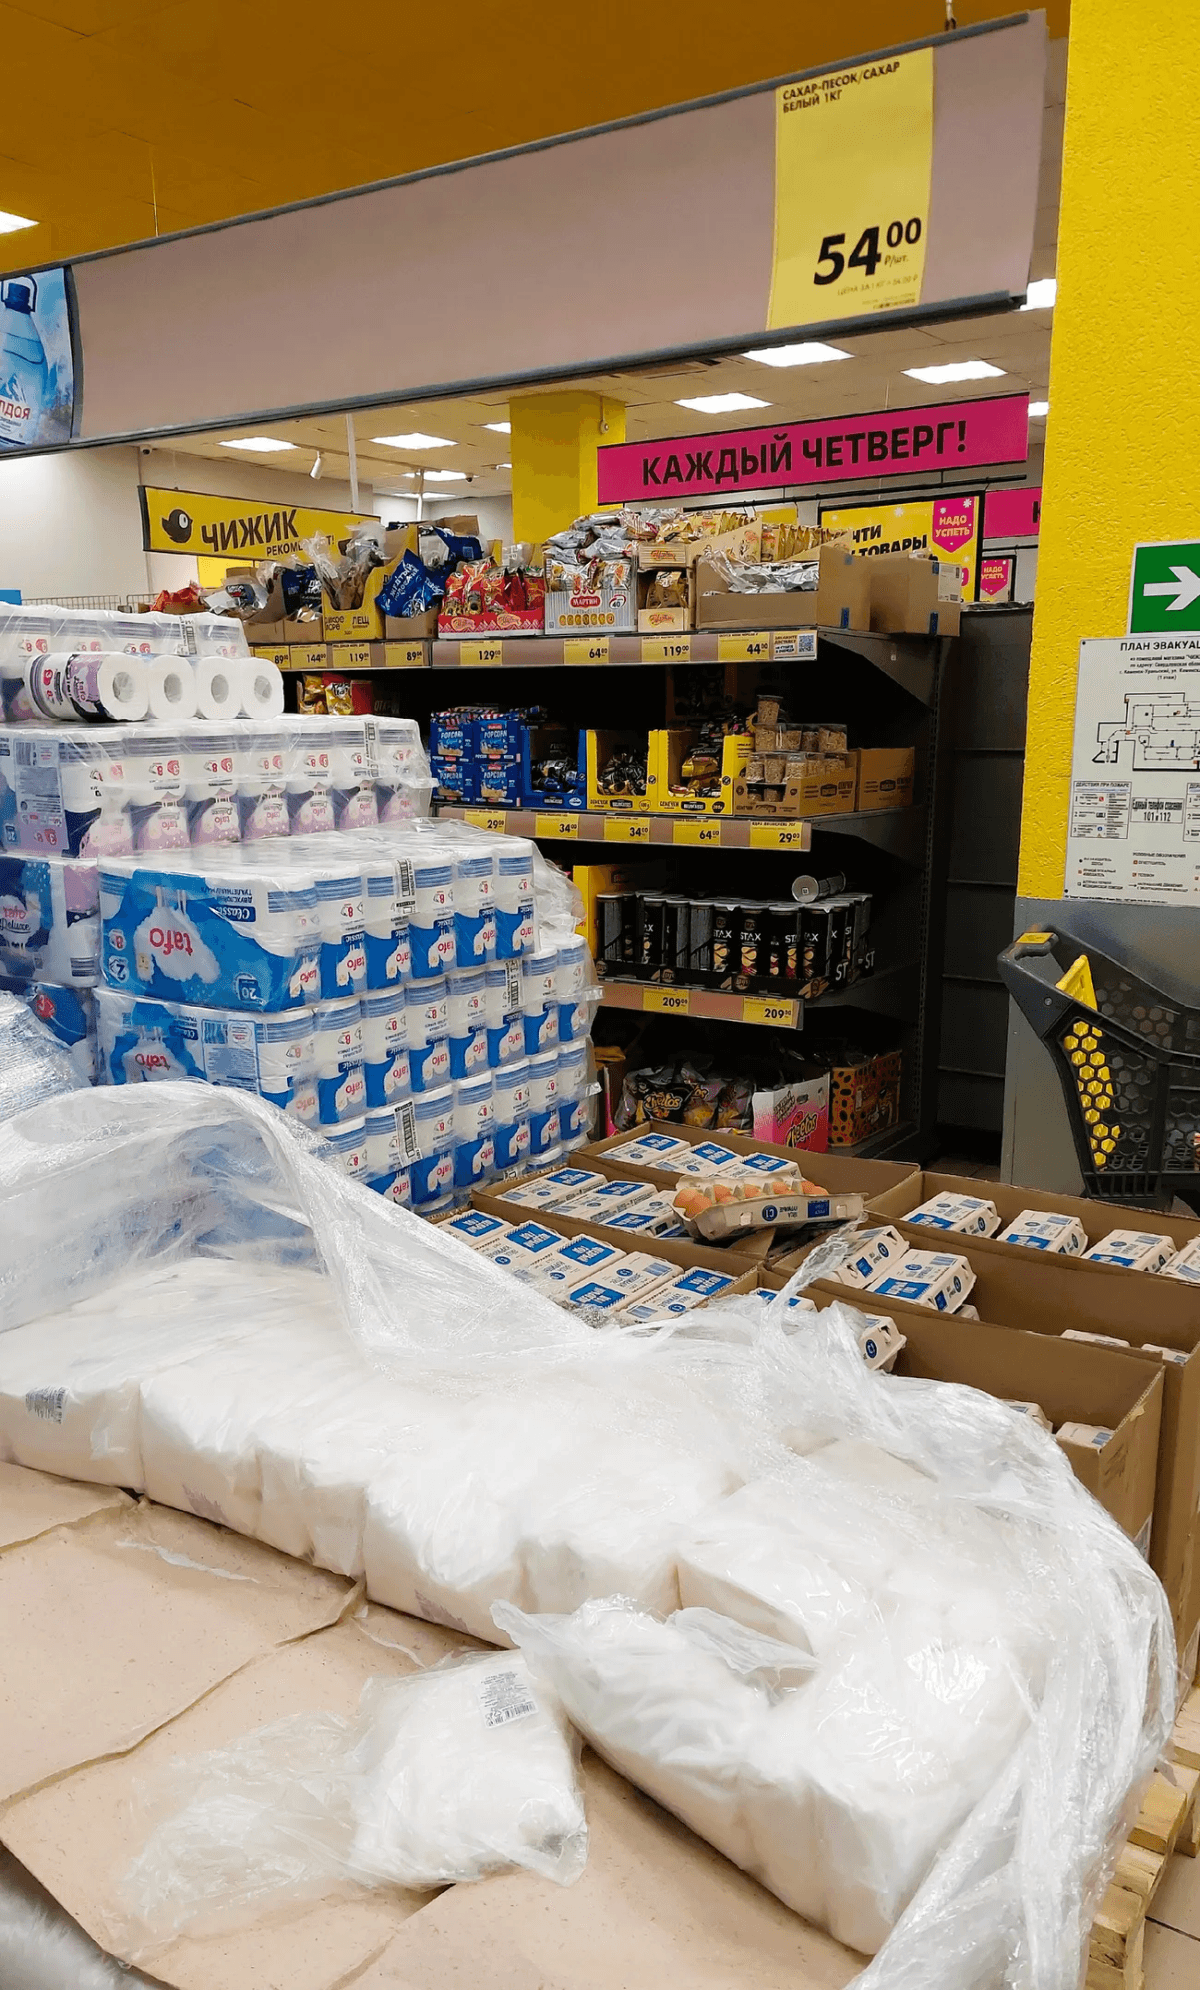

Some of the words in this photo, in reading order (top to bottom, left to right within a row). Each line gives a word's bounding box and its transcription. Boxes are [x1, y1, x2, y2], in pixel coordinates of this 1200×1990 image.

[783, 61, 900, 100] САХАР-ПЕСОК/САХАР
[783, 94, 820, 113] БЕЛЫЙ
[825, 89, 842, 103] 1КГ
[641, 433, 792, 487] КАЖДЫЙ
[801, 419, 968, 470] ЧЕТВЕРГ!
[939, 515, 968, 526] НАДО
[201, 509, 300, 552] ЧИЖИК
[935, 527, 970, 538] УСПЕТЬ
[1120, 642, 1150, 651] ПЛАН
[1159, 812, 1171, 821] 112
[149, 928, 194, 956] tafo
[740, 931, 762, 941] STAX
[134, 1053, 170, 1072] tafo
[644, 1092, 682, 1110] Cheetos
